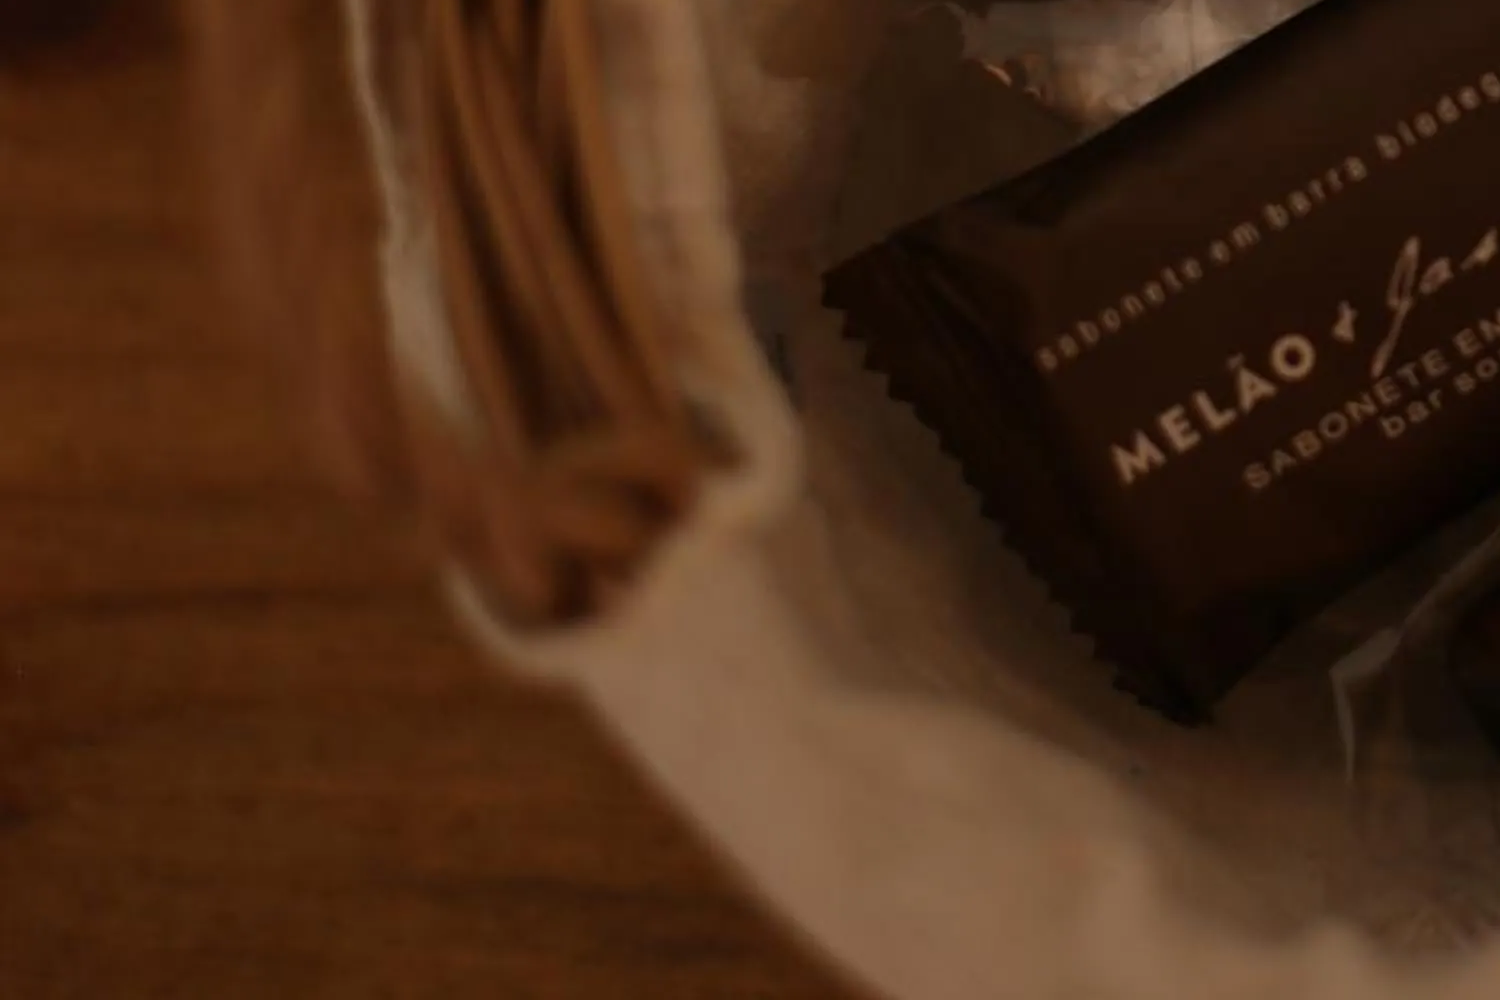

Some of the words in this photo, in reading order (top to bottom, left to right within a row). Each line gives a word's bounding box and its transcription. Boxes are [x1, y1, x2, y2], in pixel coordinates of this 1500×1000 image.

[1034, 256, 1204, 374] sabonete
[1208, 221, 1262, 268] em
[1263, 156, 1368, 231] barra
[1108, 333, 1318, 486] MELÃO
[1242, 346, 1450, 492] SABONETE
[1379, 388, 1445, 441] bar
